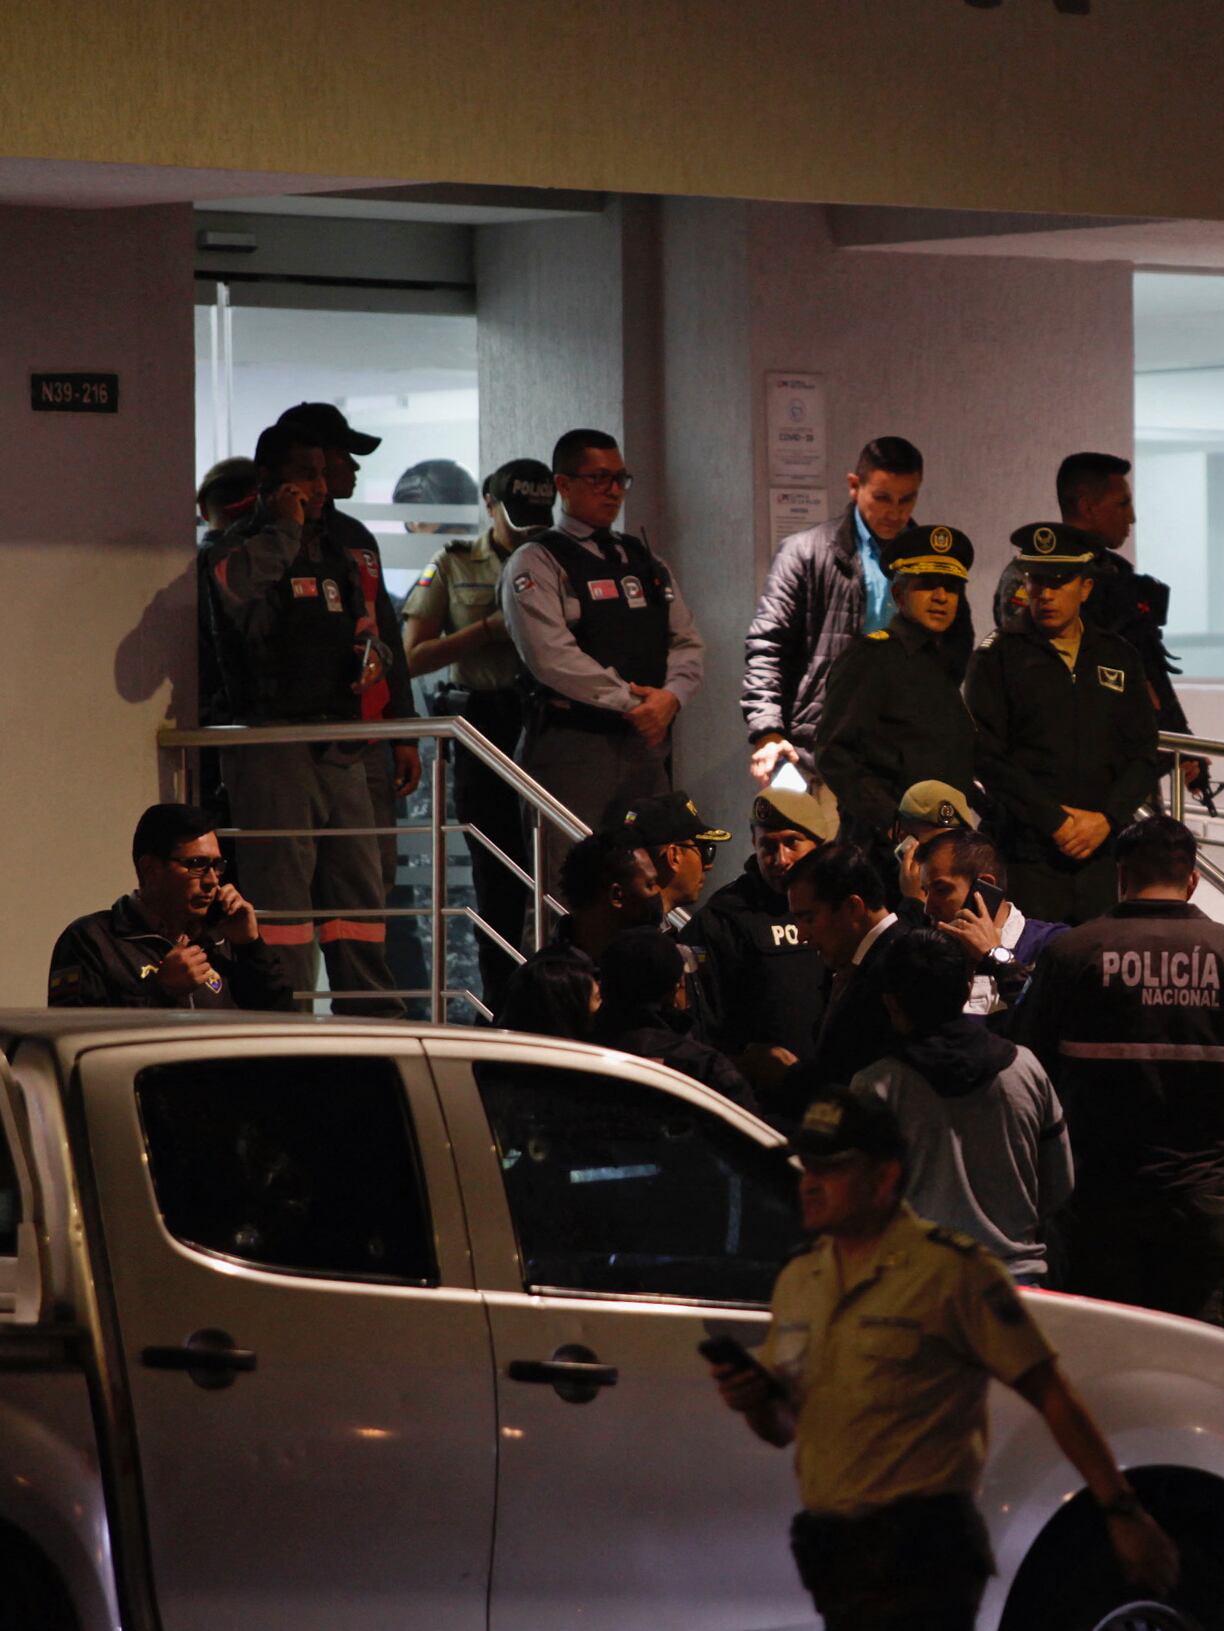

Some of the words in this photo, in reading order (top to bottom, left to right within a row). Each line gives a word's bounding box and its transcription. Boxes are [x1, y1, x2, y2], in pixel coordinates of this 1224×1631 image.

[42, 381, 109, 404] N39-216
[1102, 945, 1221, 990] POLICÍA
[1141, 988, 1221, 1008] NACIONAL
